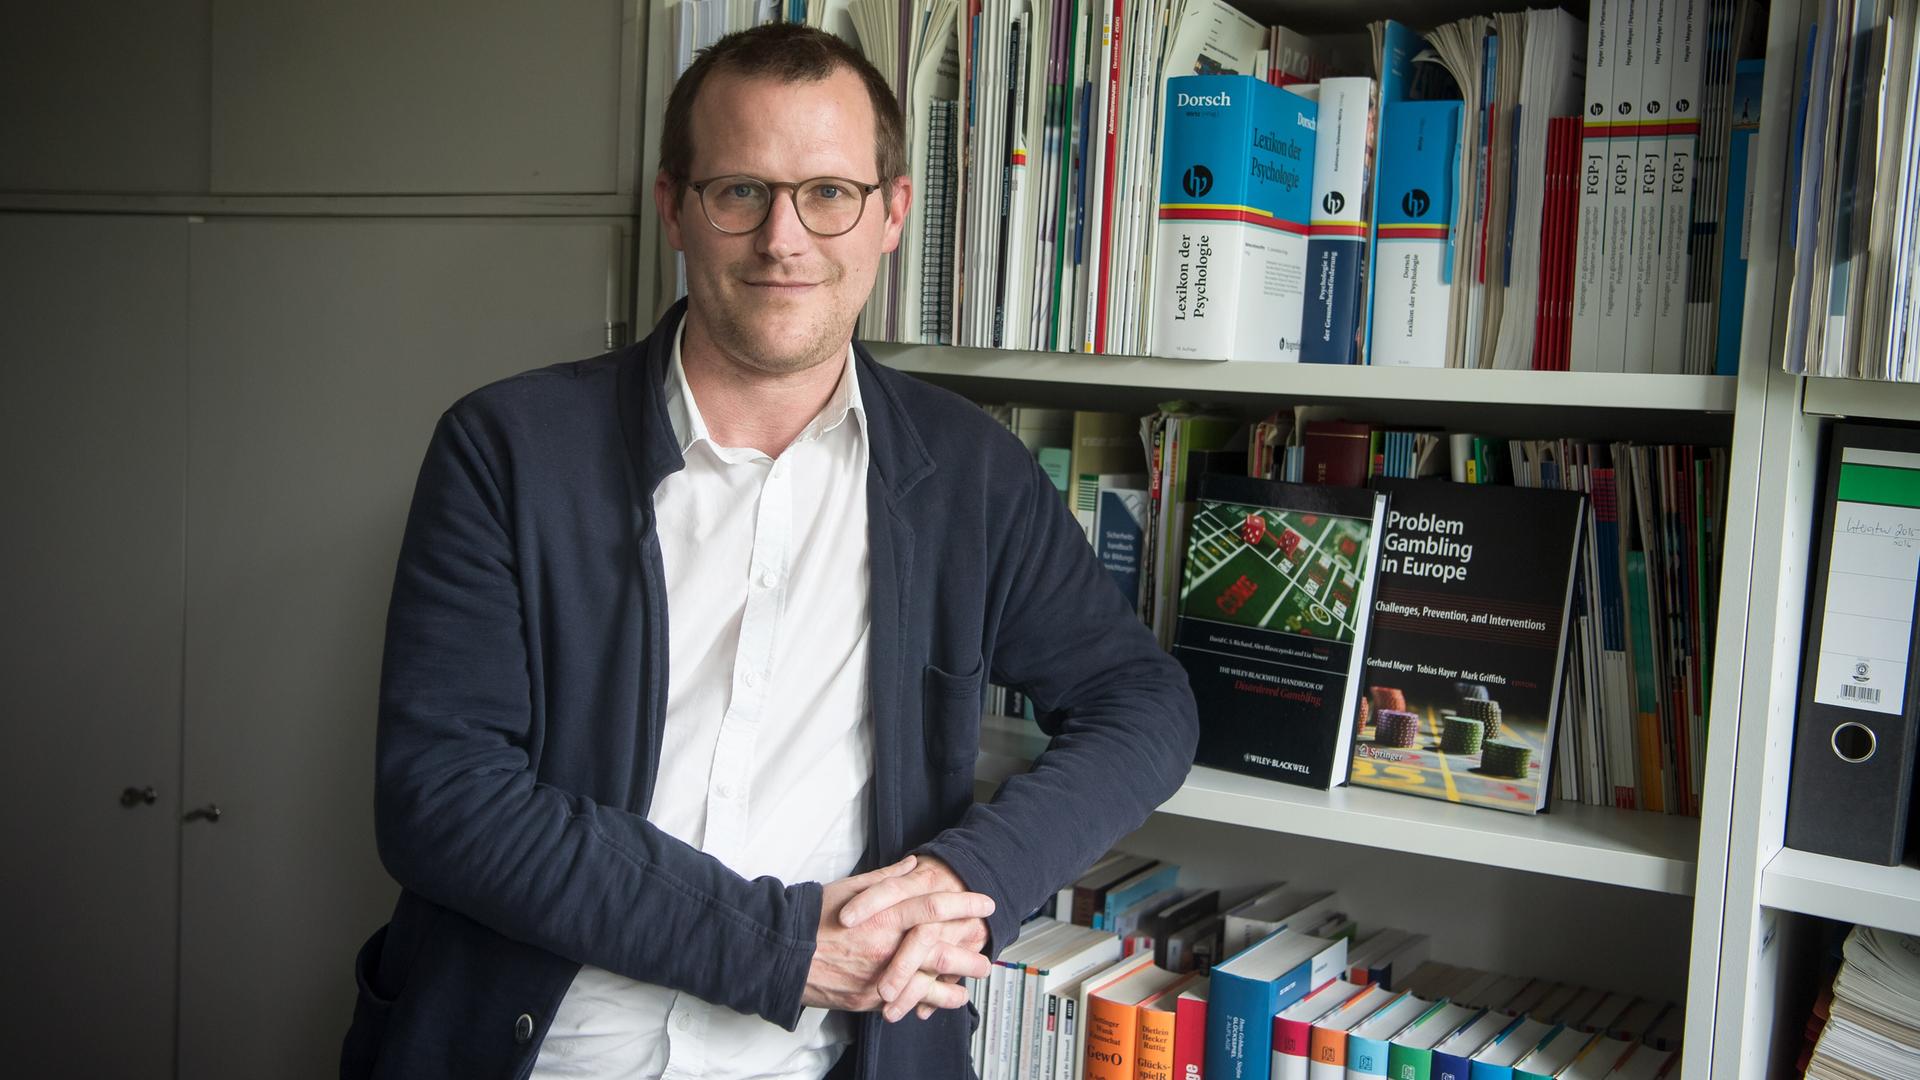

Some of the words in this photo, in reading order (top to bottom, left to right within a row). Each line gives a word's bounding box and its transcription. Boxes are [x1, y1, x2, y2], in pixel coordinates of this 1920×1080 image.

[1177, 91, 1231, 107] Dorsch
[1297, 112, 1316, 131] Dorsch
[1253, 128, 1287, 157] Lexikon
[1288, 139, 1302, 160] der
[1251, 157, 1299, 192] Psychologie
[1587, 155, 1603, 195] FGP-J
[1615, 154, 1631, 195] FGP-J
[1643, 153, 1659, 194] FGP-J
[1672, 152, 1688, 193] FGP-J
[1179, 234, 1191, 258] der
[1193, 235, 1212, 318] Psychologie
[1319, 260, 1329, 300] Psychologie
[1410, 254, 1419, 294] Psychologie
[1175, 263, 1189, 320] Lexikon
[1324, 251, 1338, 329] Gesundheitsförderung
[1388, 511, 1464, 535] Problem
[1384, 533, 1473, 563] Gambling
[1381, 554, 1398, 573] in
[1403, 556, 1467, 583] Europe
[1375, 601, 1420, 617] Challenges,
[1423, 606, 1469, 623] Prevention,
[1470, 614, 1487, 624] and
[1489, 615, 1546, 631] Interventions
[1219, 666, 1230, 674] THE
[1230, 668, 1280, 683] WILEY-BLACKWELL
[1281, 677, 1315, 690] HANDBOOK
[1315, 683, 1323, 691] OF
[1366, 658, 1392, 669] Gerhard
[1393, 661, 1413, 672] Meyer
[1417, 664, 1437, 675] Tobias
[1438, 668, 1457, 679] Hayer
[1461, 671, 1478, 681] Mark
[1479, 673, 1506, 685] Griffiths
[1235, 679, 1280, 697] Disordered
[1280, 688, 1322, 707] Gambling
[1370, 748, 1403, 762] Springer
[1142, 1025, 1168, 1035] Dietlein
[1142, 1034, 1167, 1043] Hecker
[1087, 1045, 1123, 1066] GewO
[1137, 1057, 1170, 1070] Glücks-
